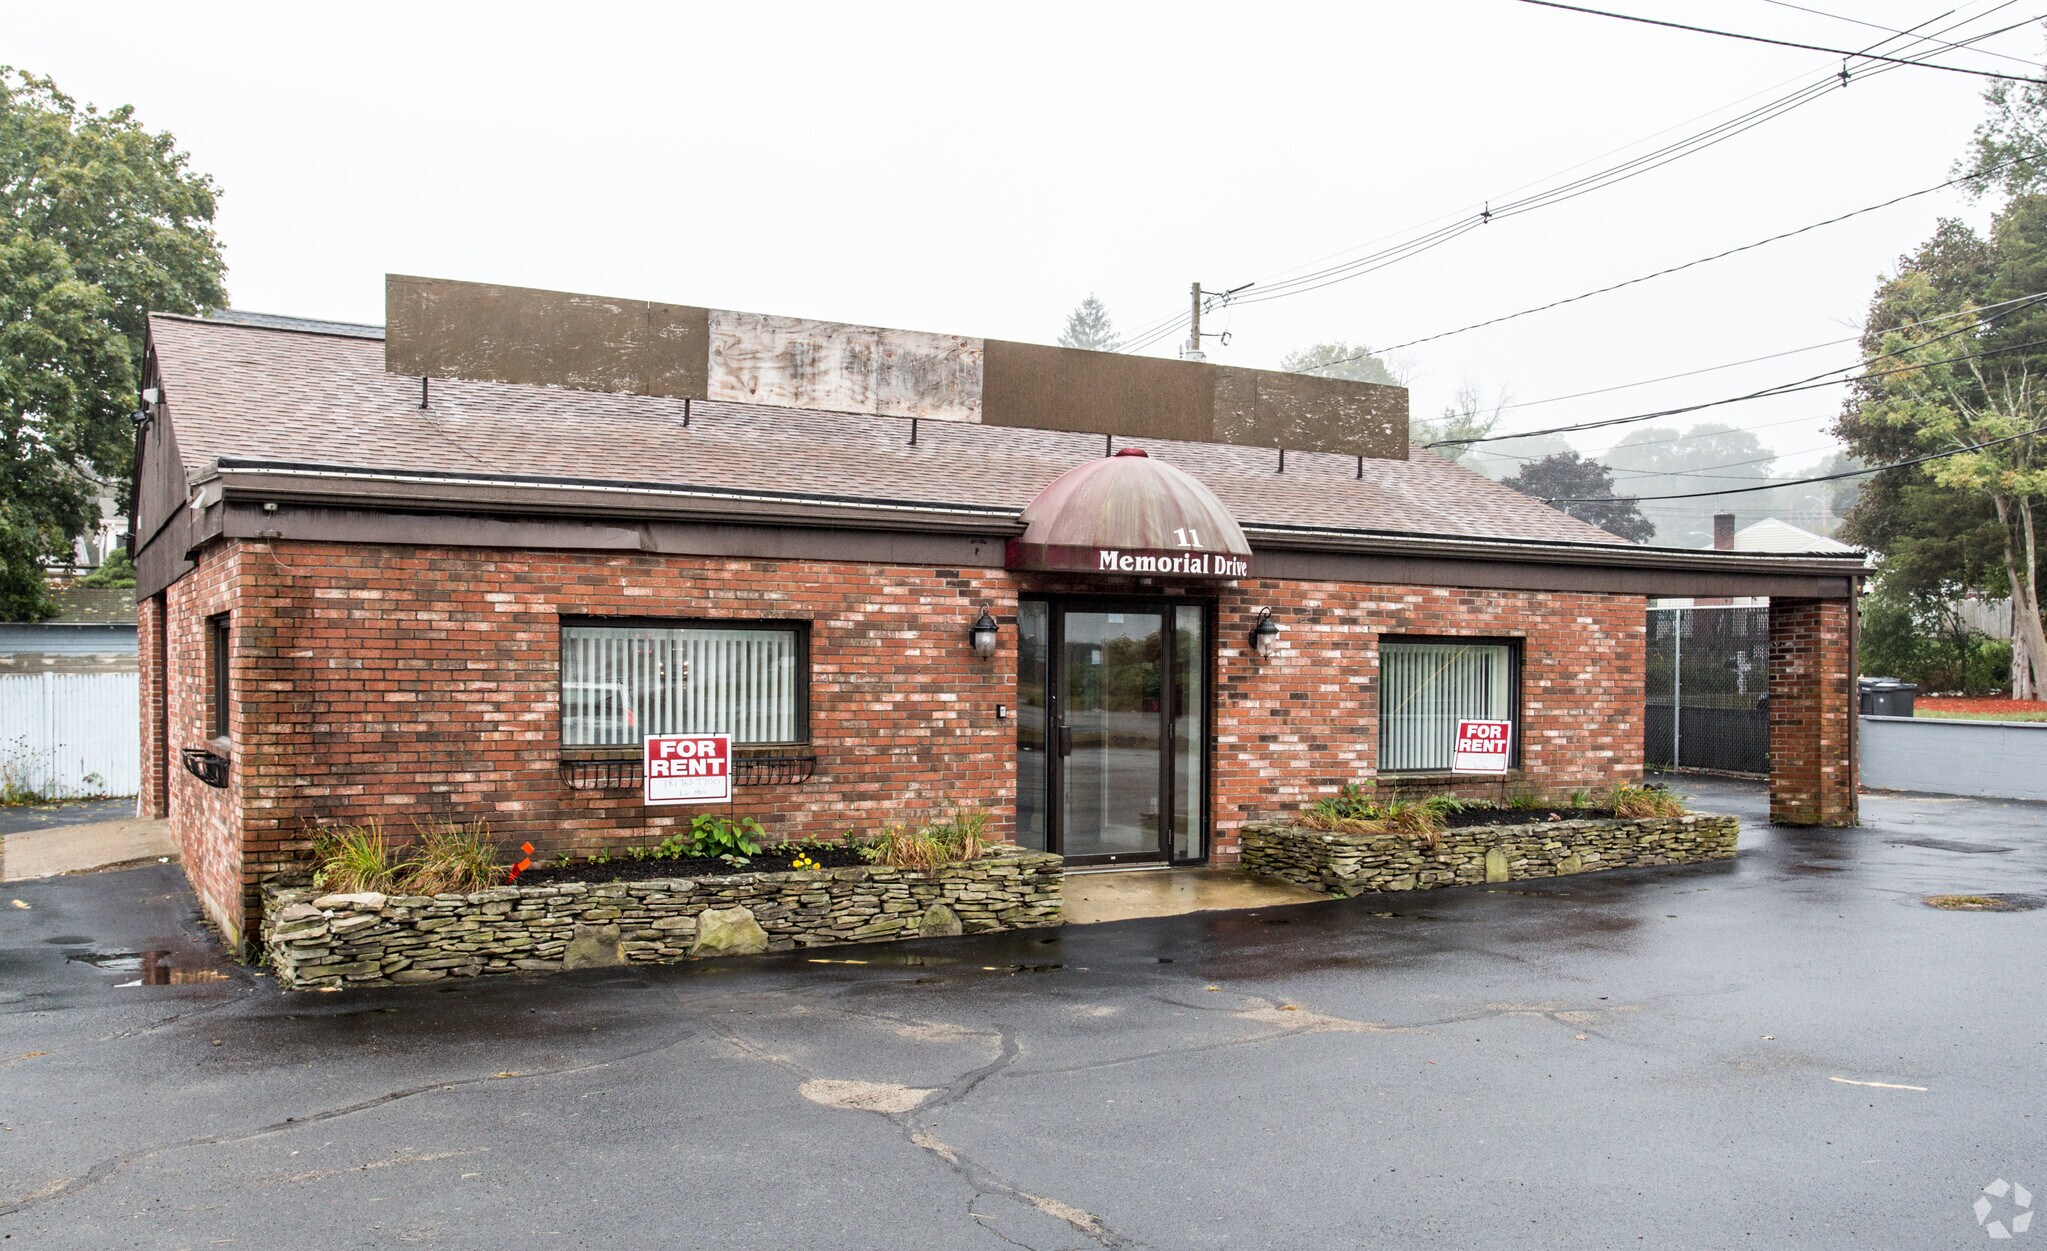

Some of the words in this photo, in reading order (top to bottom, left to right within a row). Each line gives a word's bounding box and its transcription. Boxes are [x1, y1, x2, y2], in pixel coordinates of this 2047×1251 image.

[1173, 527, 1203, 548] 11
[1099, 550, 1208, 574] Memorial
[1214, 555, 1248, 577] Drive
[1466, 725, 1502, 738] FOR
[660, 740, 716, 758] FOR
[1459, 738, 1506, 753] RENT
[650, 758, 725, 776] RENT
